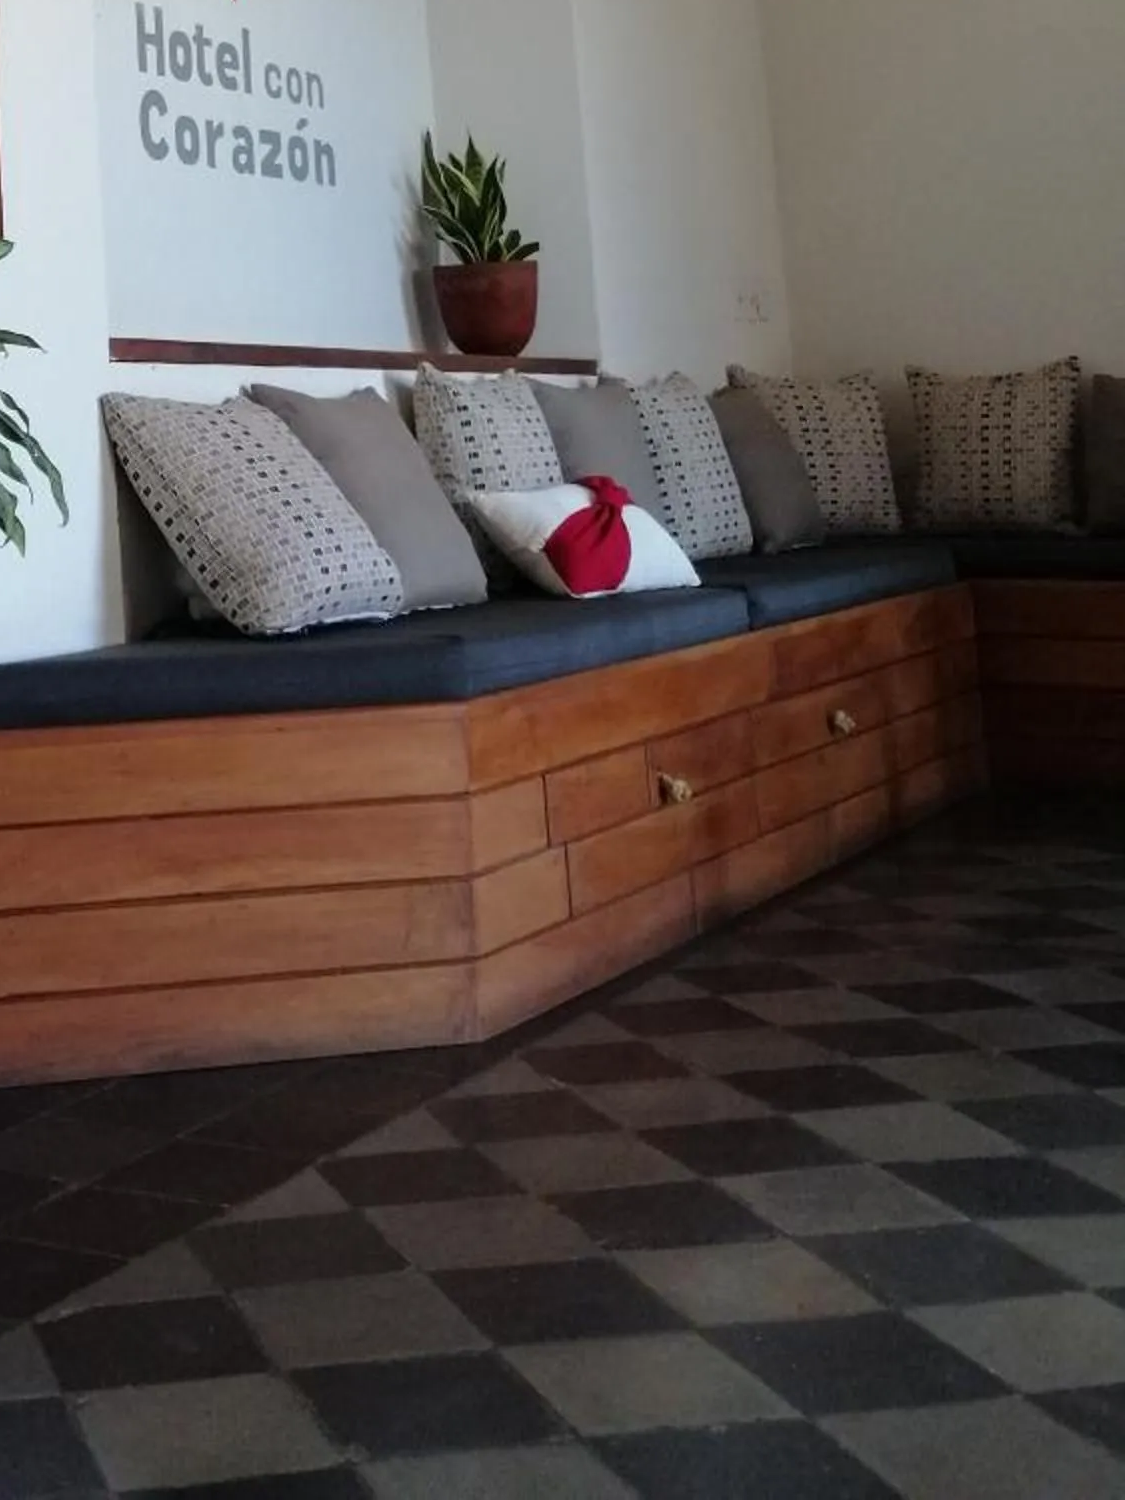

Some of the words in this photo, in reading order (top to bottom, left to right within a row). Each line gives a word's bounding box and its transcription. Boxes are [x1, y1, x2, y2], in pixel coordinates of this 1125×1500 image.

[134, 1, 253, 94] Hotel
[264, 62, 325, 110] con
[139, 88, 336, 187] Corazón
